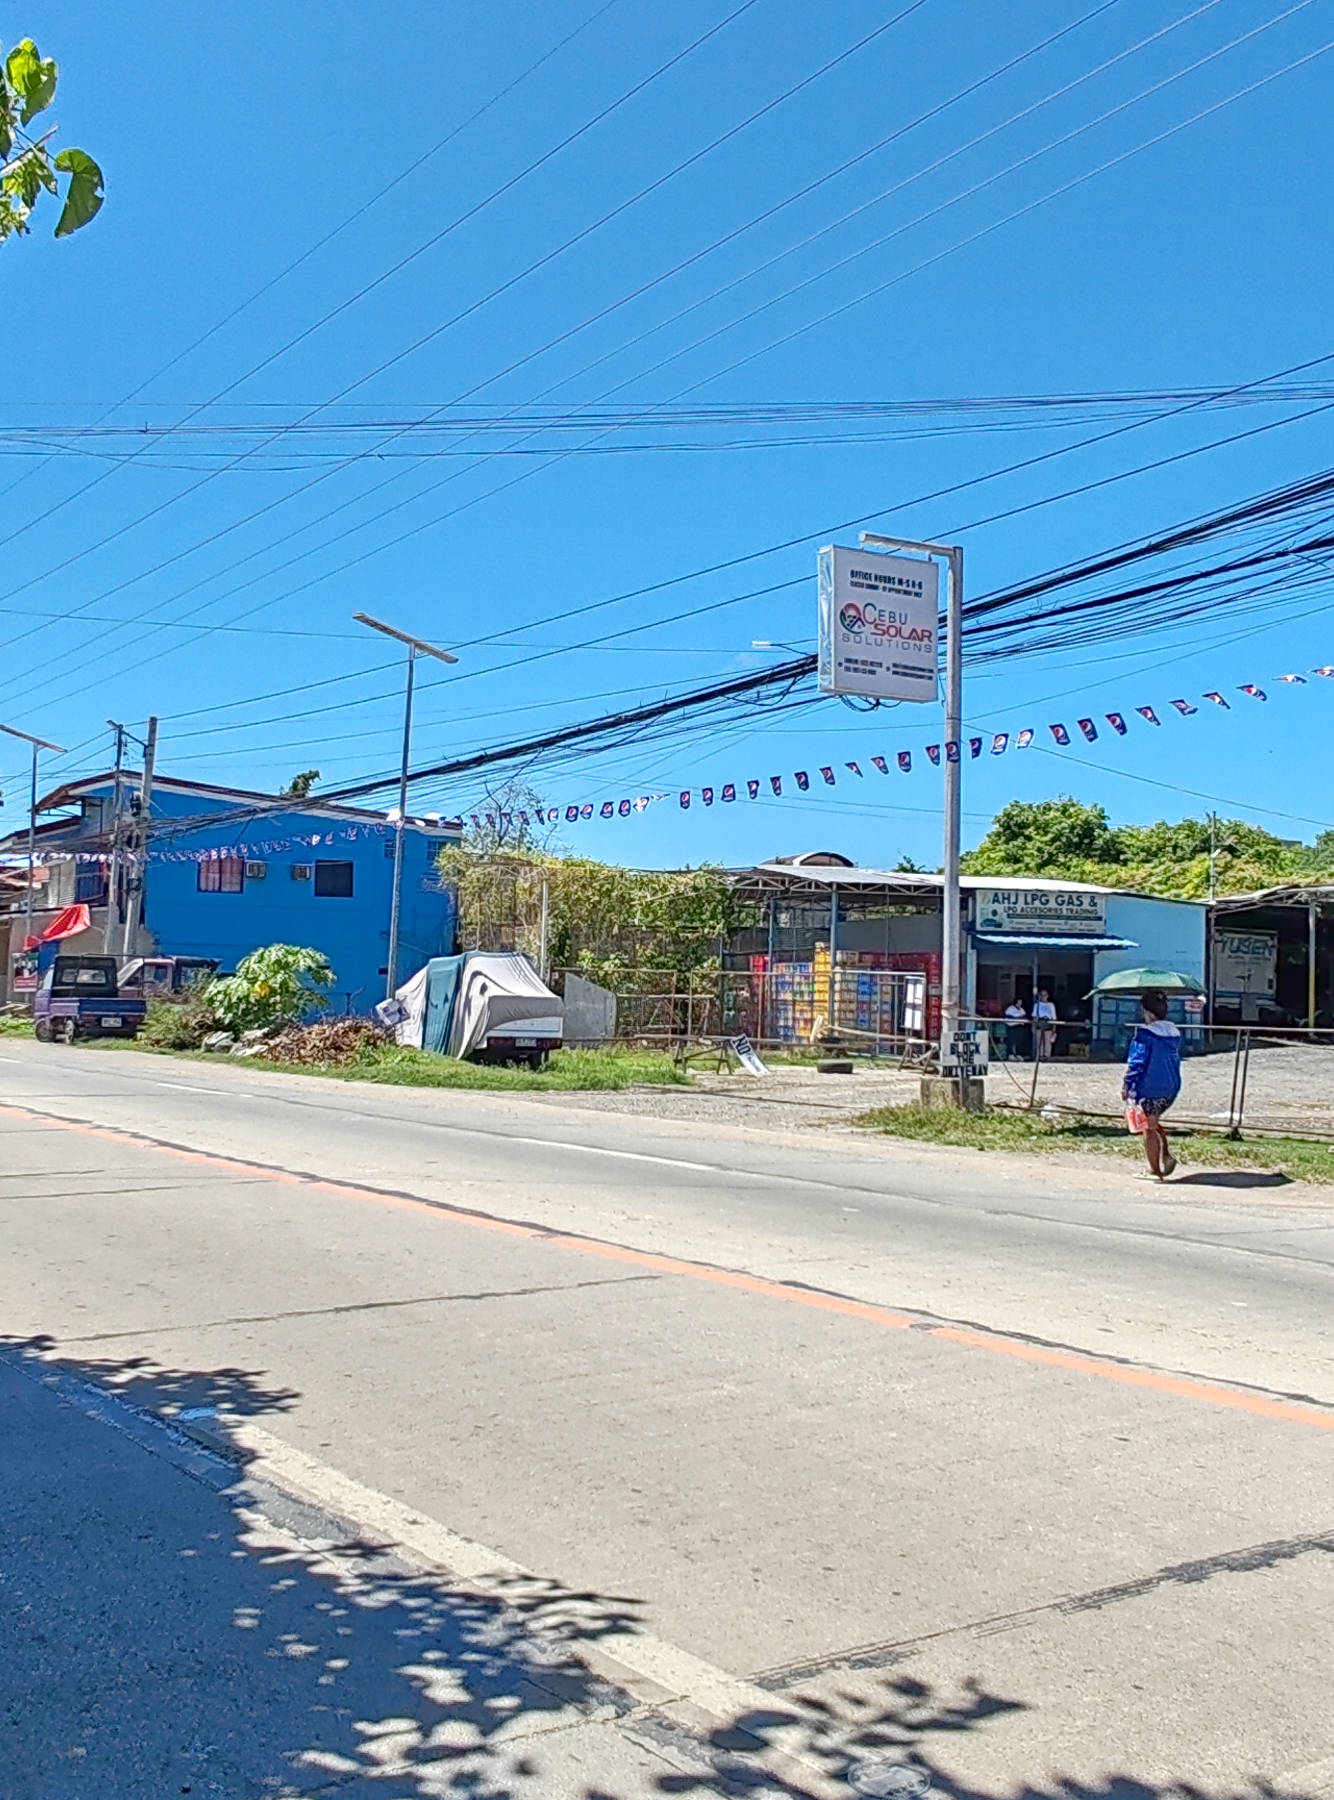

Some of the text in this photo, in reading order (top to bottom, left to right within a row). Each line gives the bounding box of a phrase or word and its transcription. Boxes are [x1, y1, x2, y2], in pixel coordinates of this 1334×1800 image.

[850, 569, 873, 582] OFFICE
[874, 573, 896, 586] HOURS
[863, 602, 908, 625] CEBU
[870, 623, 933, 643] SOLAR
[841, 632, 933, 653] SOLUTIONS
[992, 892, 1098, 908] AHJ LPG GAS &
[1003, 906, 1018, 914] LPG
[1065, 907, 1098, 916] TRADING
[950, 1041, 982, 1056] BLOCK
[956, 1050, 975, 1066] THE
